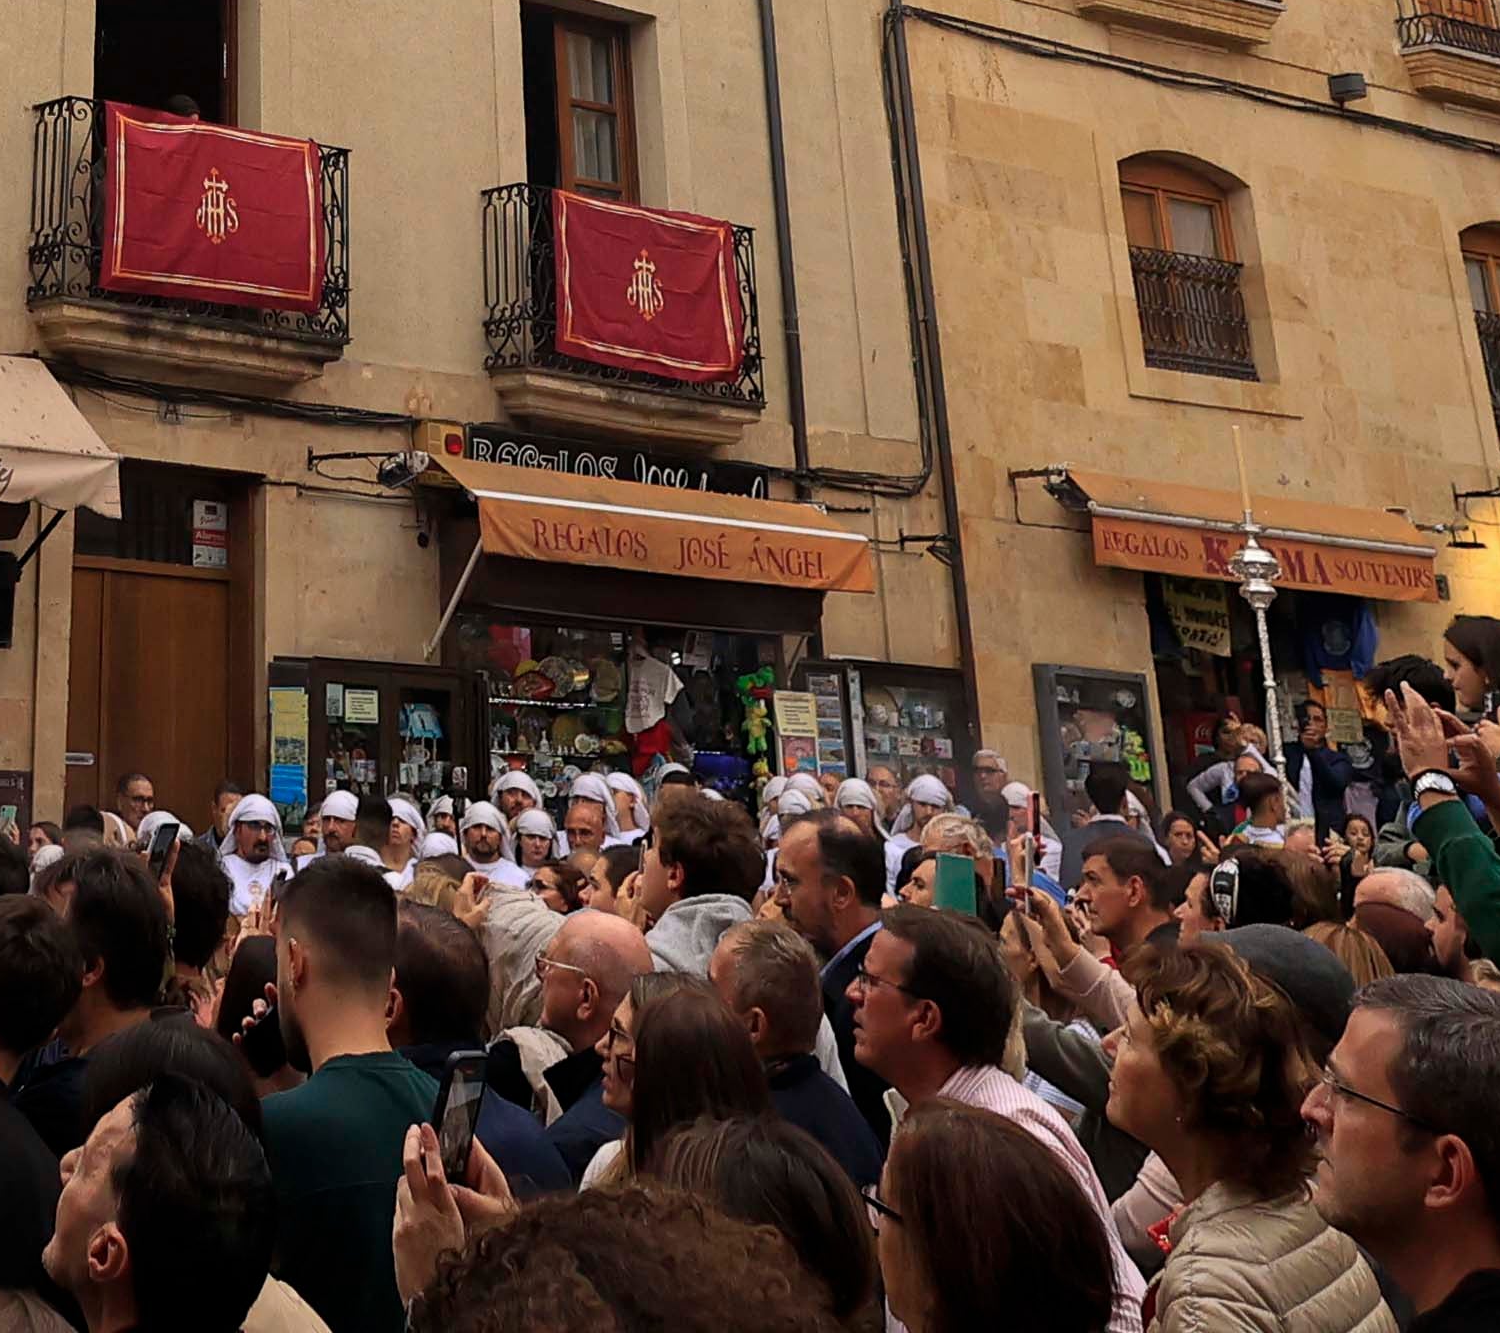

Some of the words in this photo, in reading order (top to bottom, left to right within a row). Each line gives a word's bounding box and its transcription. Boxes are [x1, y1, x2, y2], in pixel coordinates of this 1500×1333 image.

[532, 518, 648, 561] REGALOS
[673, 532, 731, 570] JOSÉ
[748, 536, 831, 581] ÁNGEL
[1102, 529, 1189, 561] REGALOS
[1201, 535, 1333, 586] KMA
[1334, 558, 1433, 588] SOUVENIRS
